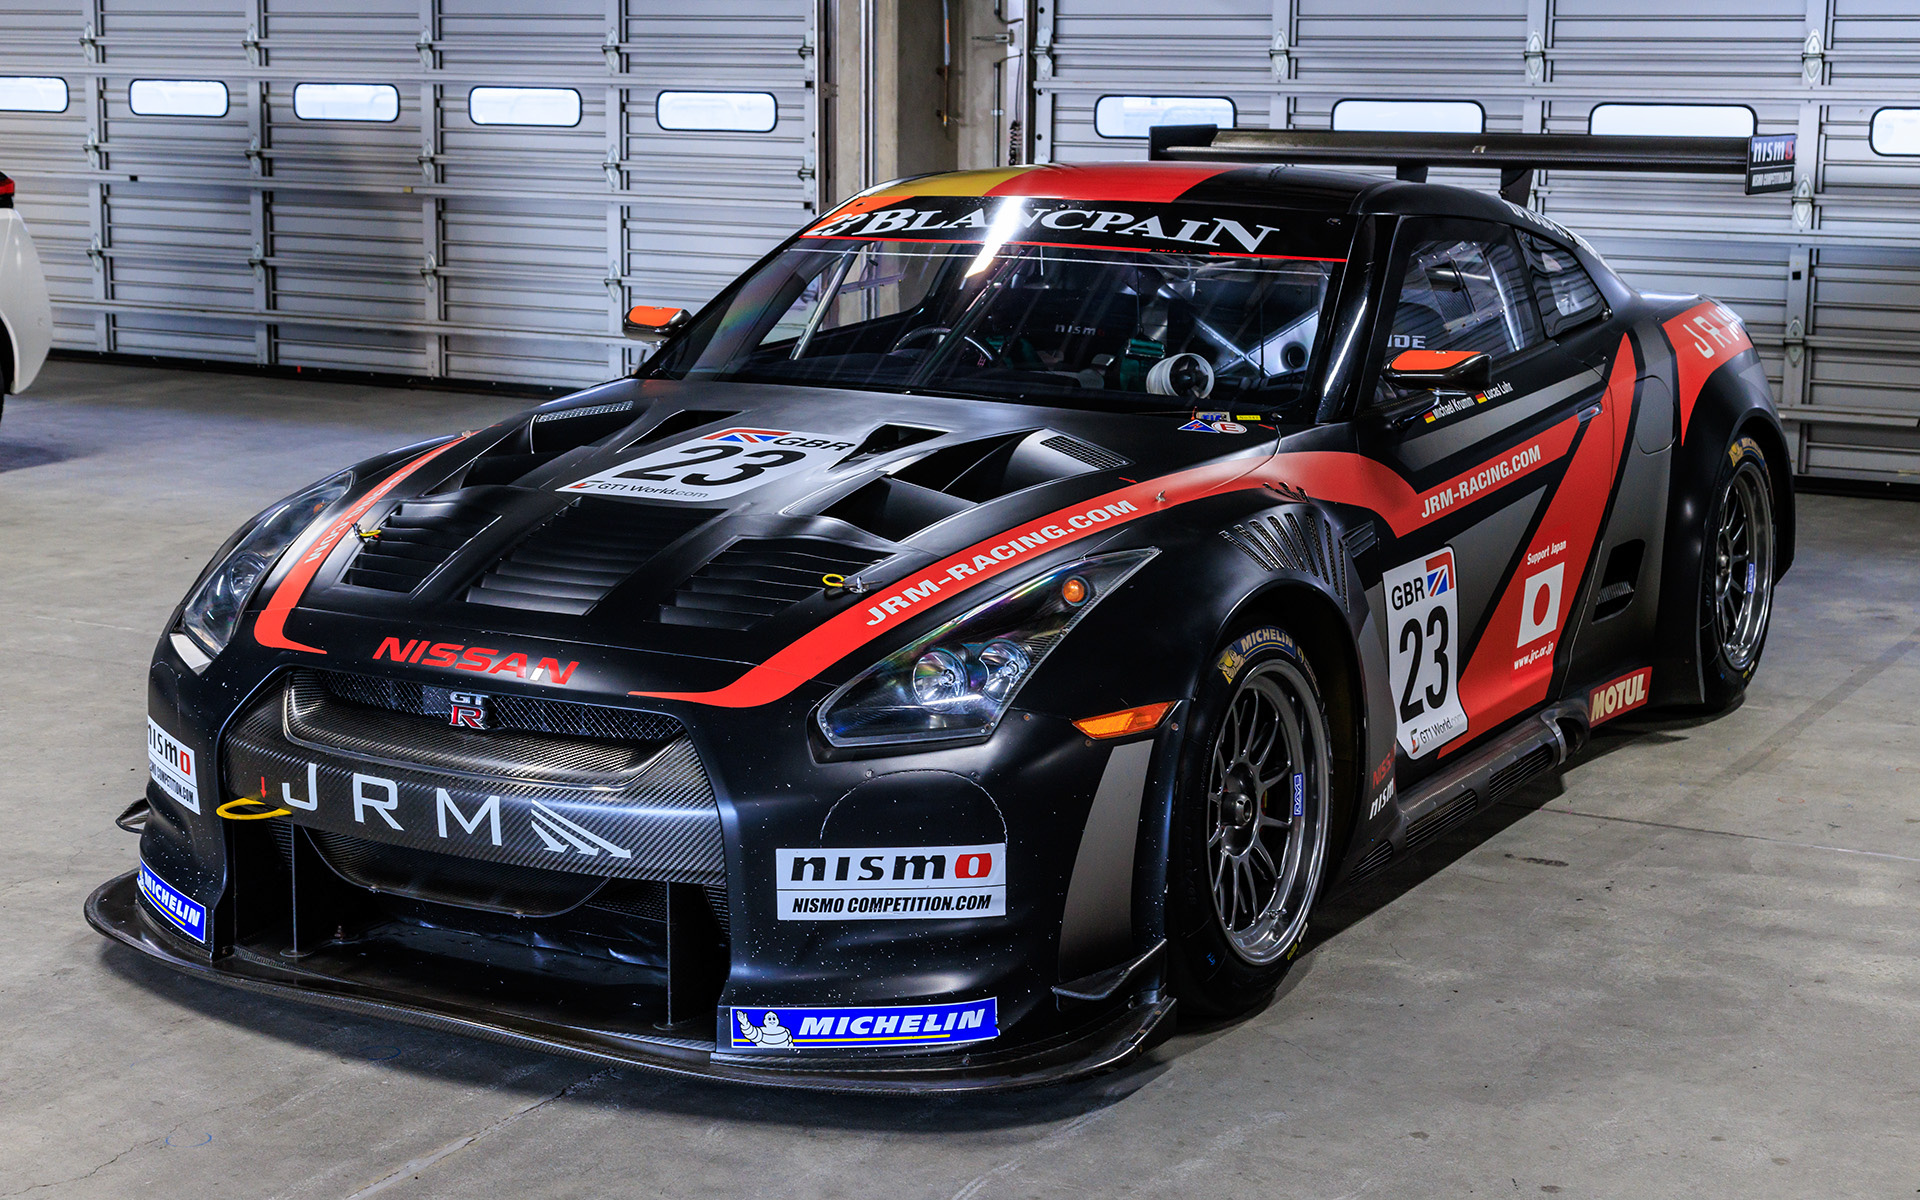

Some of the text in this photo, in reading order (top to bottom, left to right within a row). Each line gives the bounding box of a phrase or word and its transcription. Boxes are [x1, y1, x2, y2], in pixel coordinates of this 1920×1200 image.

[1752, 141, 1794, 163] nismo
[803, 208, 1280, 252] 23 BLANCPAIN
[1055, 323, 1106, 337] nismo
[1483, 381, 1514, 400] Lucas Luhr
[1432, 396, 1475, 420] Michael Krumm
[772, 437, 856, 451] GBR
[611, 444, 807, 486] 23
[598, 482, 709, 498] GT1 World.com
[1421, 444, 1541, 518] JRM-RACING.COM
[865, 500, 1139, 626] JRM-RACING.COM
[1527, 540, 1567, 566] Support Japan
[1391, 576, 1426, 611] GBR
[1241, 628, 1293, 652] MICHELIN
[1514, 640, 1554, 670] www.jrc.or.jp
[372, 636, 579, 685] NISSAN
[1399, 605, 1449, 724] 23
[450, 691, 489, 706] GT
[1590, 673, 1645, 722] MOTUL
[449, 704, 485, 730] R
[1419, 712, 1464, 744] GT1 World.com
[148, 723, 191, 776] nismo
[282, 762, 502, 846] JRM
[1369, 777, 1396, 821] nism
[791, 852, 992, 881] nismo
[144, 871, 201, 927] MICHELIN
[792, 894, 992, 913] NISMO COMPETITION.COM
[798, 1008, 985, 1036] MICHELIN
